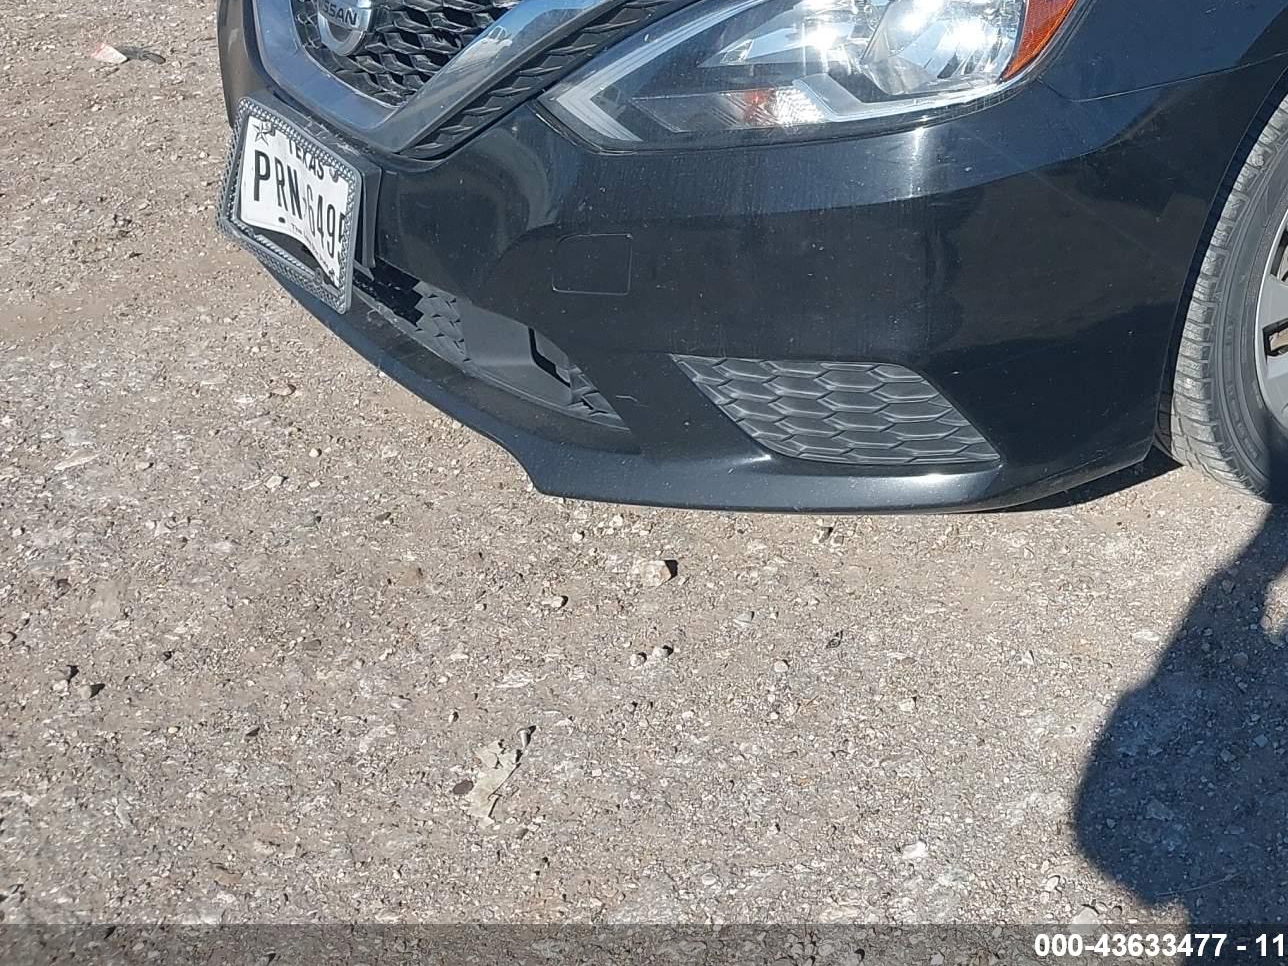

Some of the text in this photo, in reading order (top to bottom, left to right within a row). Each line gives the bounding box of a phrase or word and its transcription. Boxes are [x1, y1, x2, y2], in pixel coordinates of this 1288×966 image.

[321, 0, 358, 26] SSAN
[287, 138, 324, 181] TEXAS
[253, 149, 303, 220] PRN
